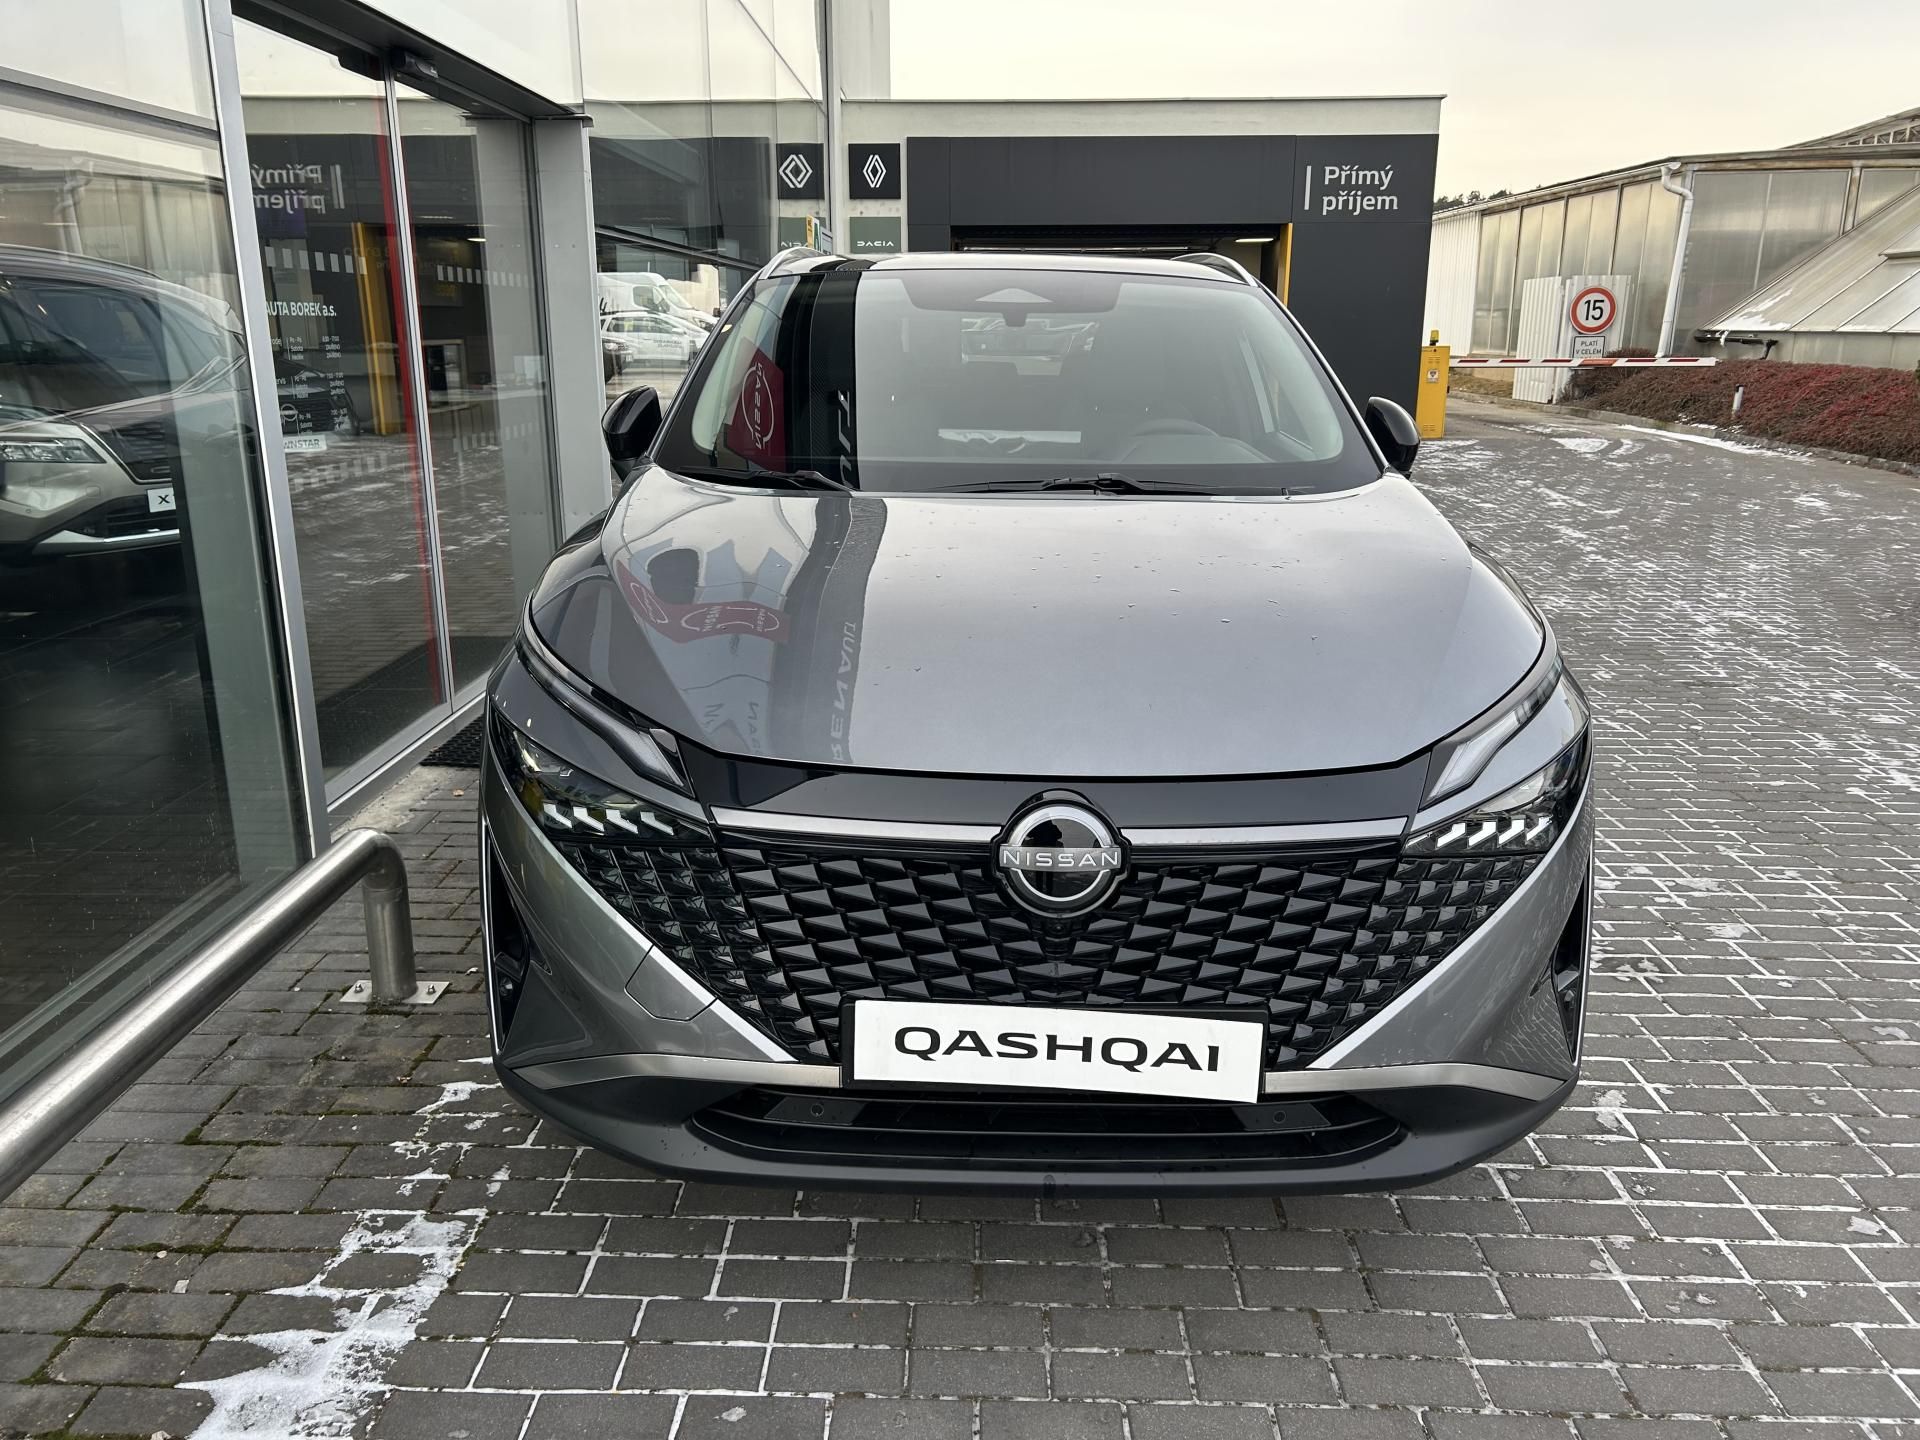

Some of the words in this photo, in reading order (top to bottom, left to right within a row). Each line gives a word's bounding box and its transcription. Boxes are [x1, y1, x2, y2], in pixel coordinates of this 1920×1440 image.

[1324, 164, 1393, 190] Přímý
[1322, 190, 1398, 215] příjem
[290, 302, 321, 316] BOREK
[322, 305, 337, 317] a.s.
[1584, 299, 1604, 320] 15
[1002, 848, 1119, 868] NISSAN
[894, 1026, 1220, 1073] QASHQAI
